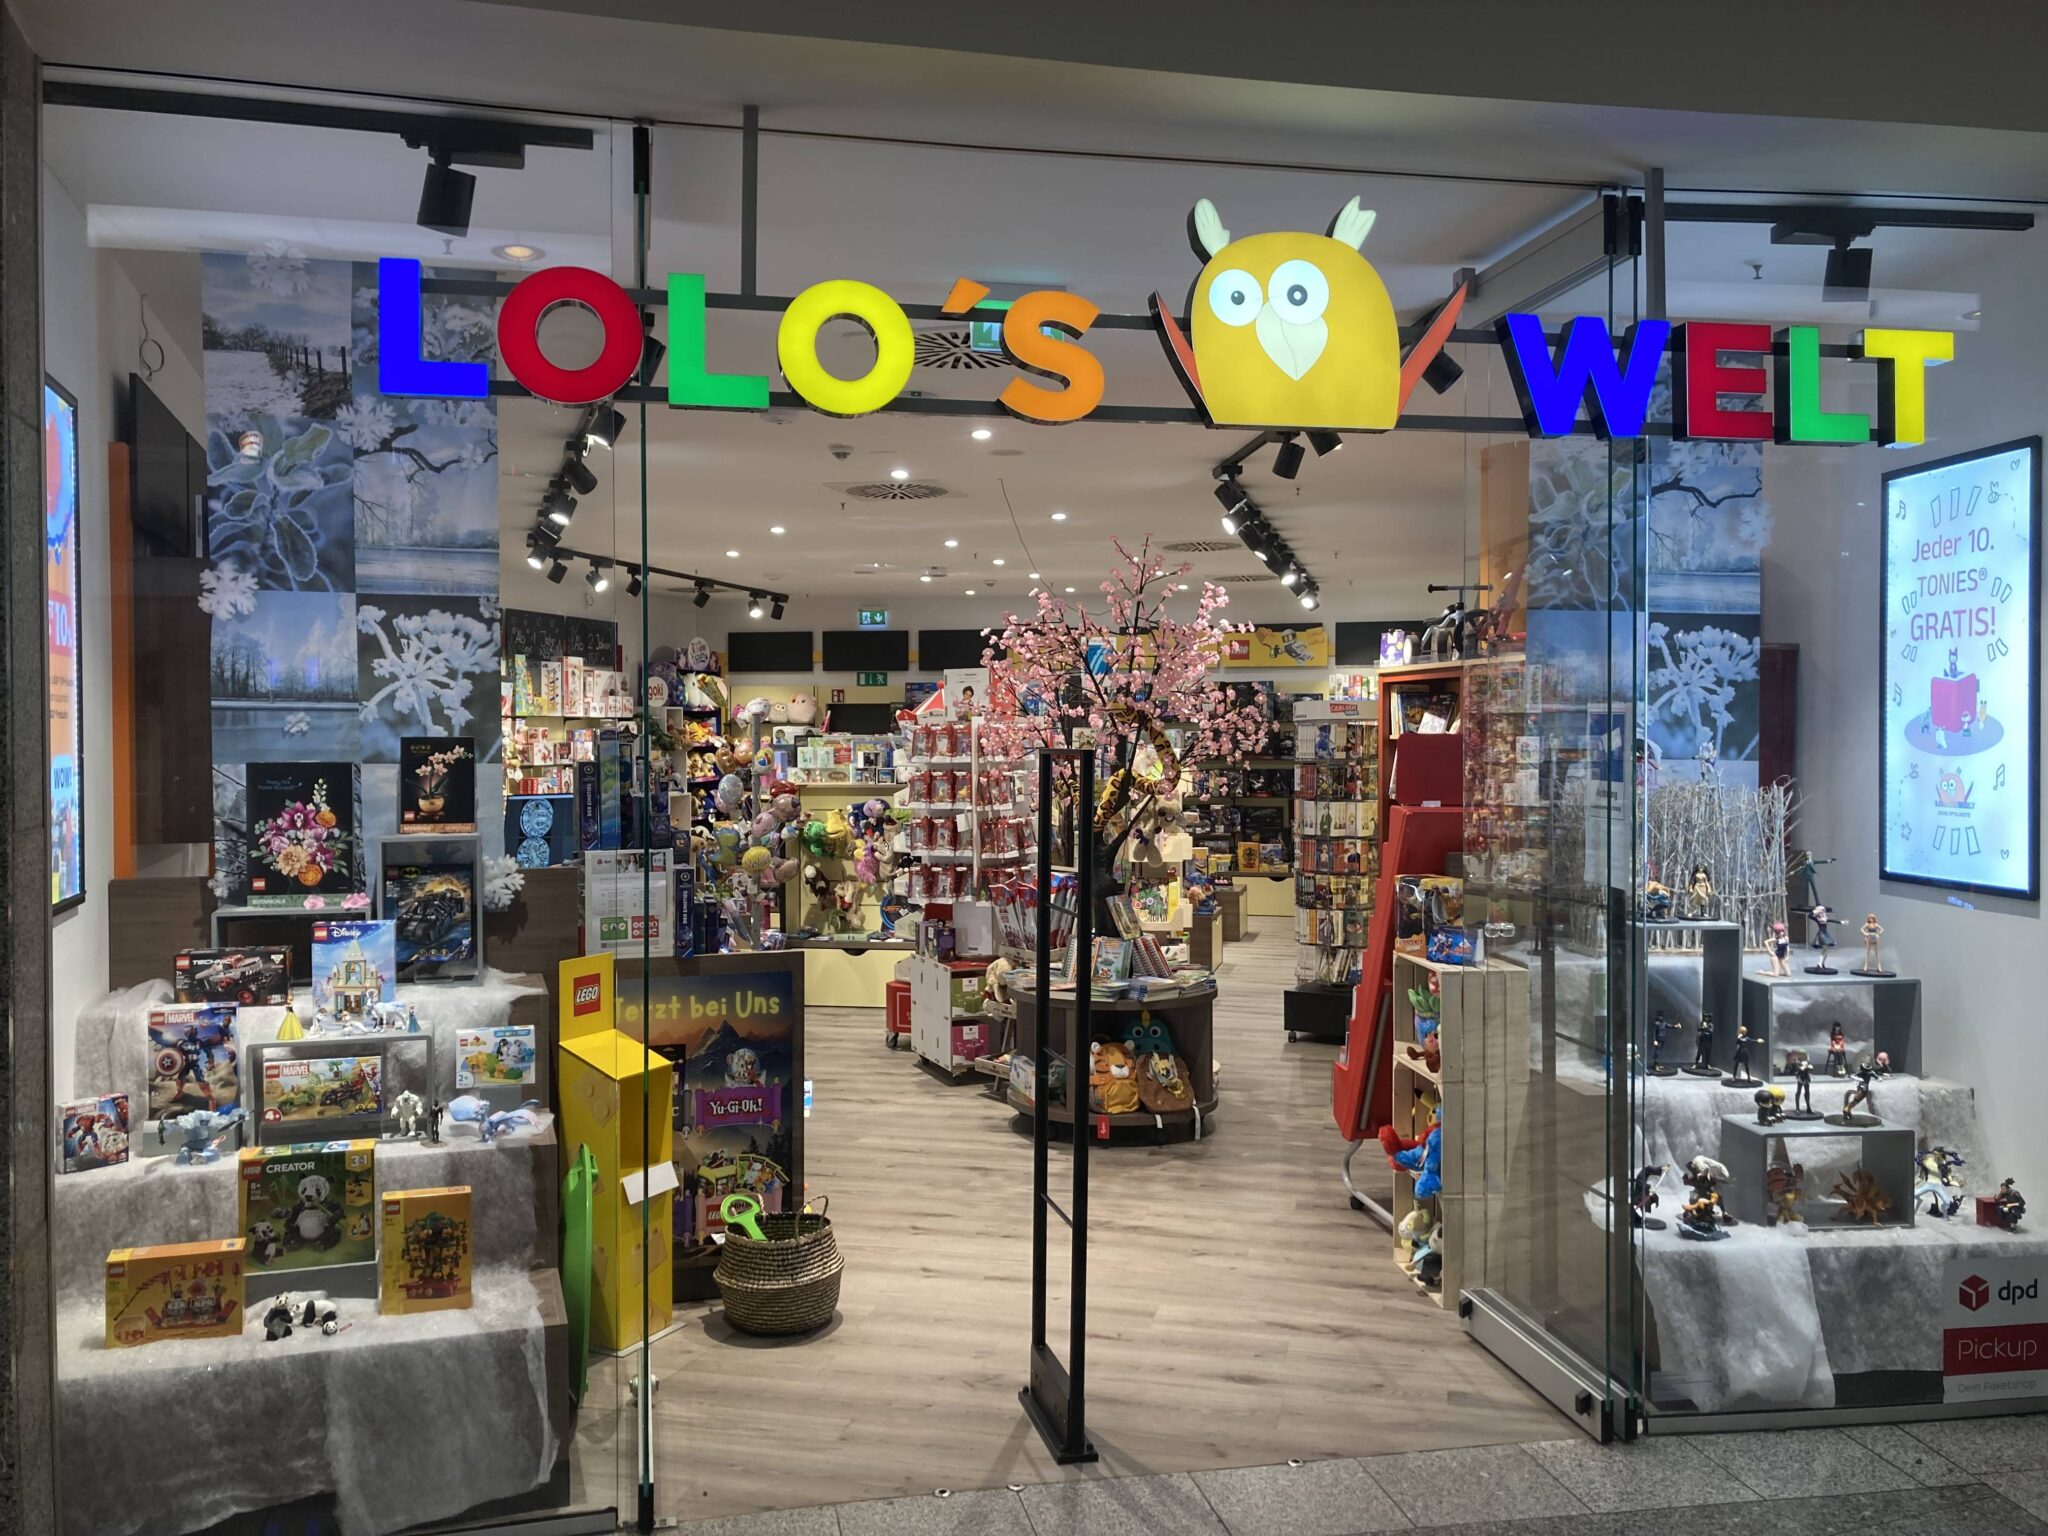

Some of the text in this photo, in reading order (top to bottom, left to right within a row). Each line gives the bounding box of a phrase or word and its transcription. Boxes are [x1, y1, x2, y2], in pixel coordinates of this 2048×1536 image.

[378, 256, 1955, 444] LOLO'S WELT
[1911, 526, 1995, 563] Jeder 10.
[1910, 606, 1996, 642] GRATIS!
[647, 683, 664, 701] goki
[53, 766, 73, 790] WOW!
[575, 983, 600, 1006] LEGO
[690, 994, 727, 1019] bei
[735, 990, 780, 1019] Uns
[283, 1065, 309, 1076] MARVEL
[710, 1098, 763, 1116] Yu-Gi-Oh!
[265, 1161, 316, 1174] CREATOR
[1997, 1277, 2038, 1306] dpd
[1958, 1337, 2037, 1362] Pickup
[1958, 1381, 1981, 1394] Dein
